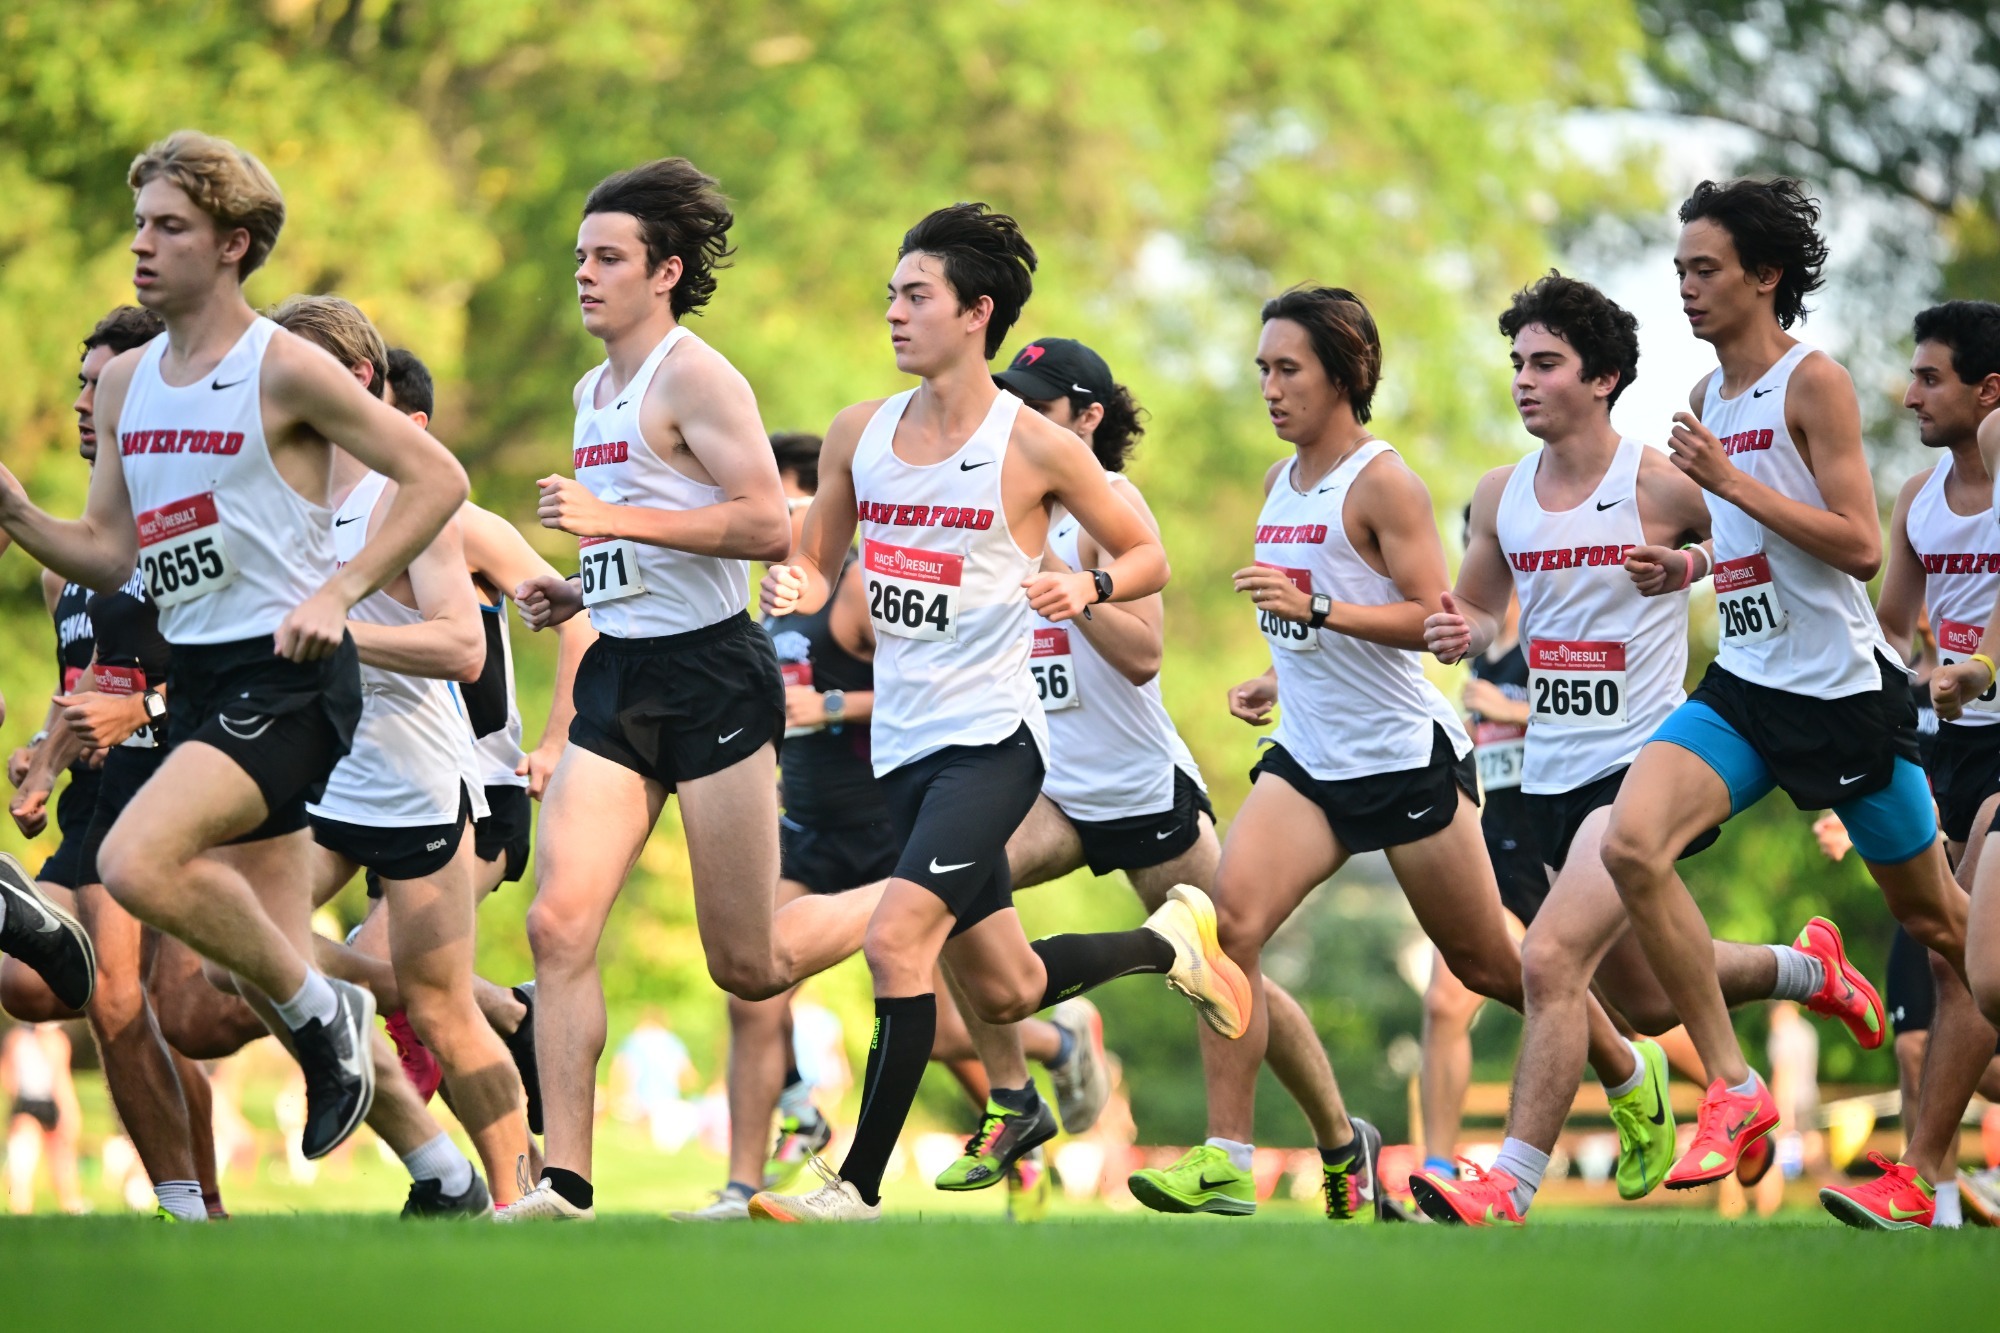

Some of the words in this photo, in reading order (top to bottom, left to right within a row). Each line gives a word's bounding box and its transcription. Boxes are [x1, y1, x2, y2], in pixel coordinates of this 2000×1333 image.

[122, 429, 245, 456] HAVERFORD
[165, 507, 196, 528] RESULT
[859, 501, 994, 530] HAVERFORD
[145, 537, 224, 598] 2655
[874, 552, 894, 567] RACE
[906, 558, 943, 574] RESULT
[1731, 566, 1755, 580] RESULT
[869, 580, 949, 632] 2664
[1719, 592, 1777, 638] 2661
[1033, 637, 1055, 649] ESULT
[1949, 631, 1967, 645] RACE
[1540, 650, 1559, 661] RACE
[1570, 651, 1607, 662] RESULT
[1535, 677, 1619, 716] 2650
[426, 838, 447, 852] BOA
